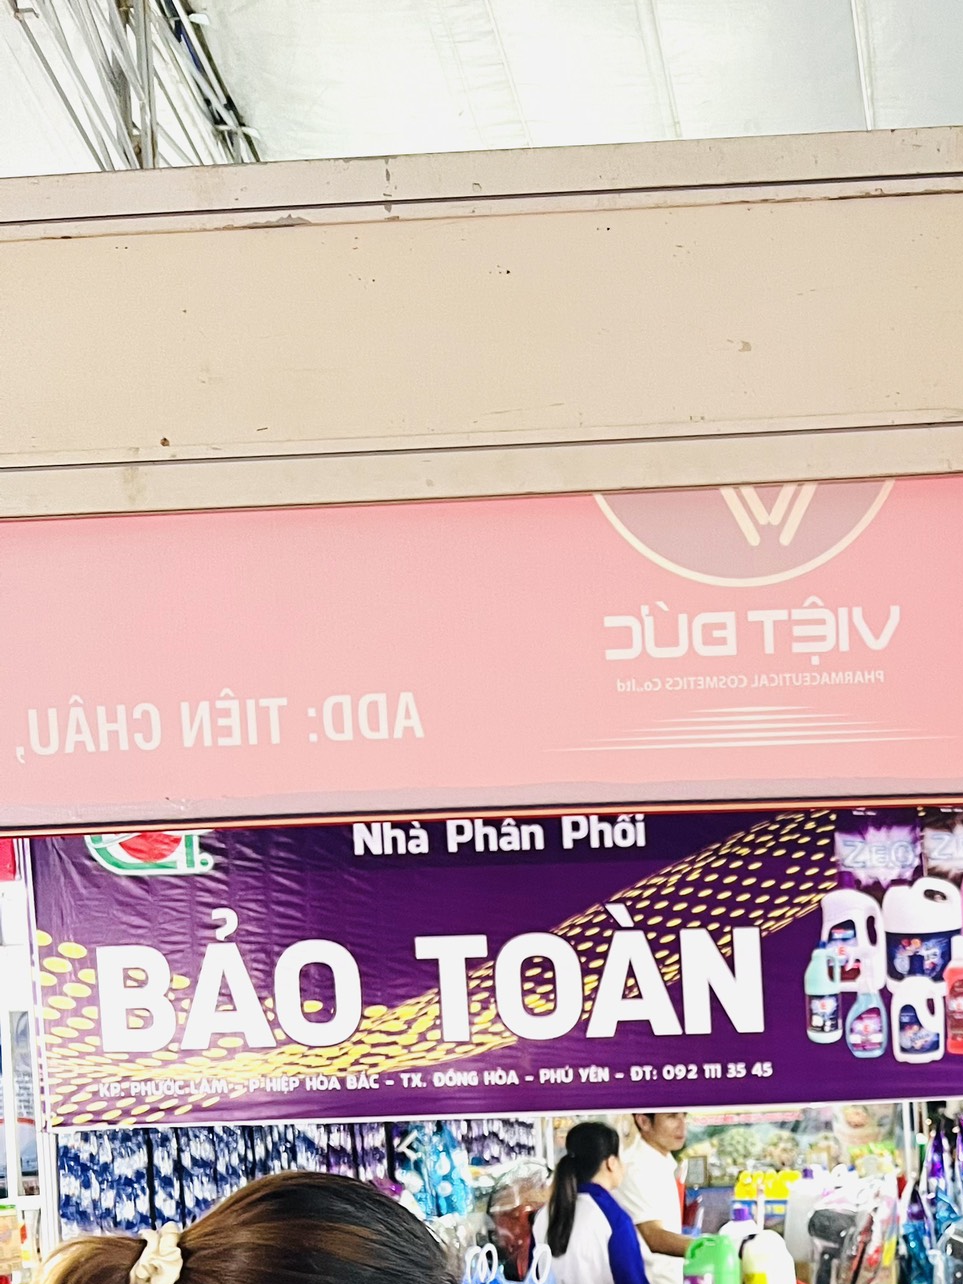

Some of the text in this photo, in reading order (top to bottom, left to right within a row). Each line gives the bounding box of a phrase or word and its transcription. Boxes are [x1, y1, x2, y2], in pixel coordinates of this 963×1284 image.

[352, 812, 646, 856] Nhà Phân Phối
[96, 902, 767, 1052] BẢO TOÀN
[401, 1073, 427, 1088] TX.
[539, 1065, 574, 1085] PHÚ
[579, 1064, 610, 1083] YÊN
[630, 1066, 658, 1082] ĐT:
[662, 1064, 698, 1081] 092
[703, 1063, 722, 1080] 111
[726, 1062, 747, 1078] 35
[751, 1061, 774, 1078] 45
